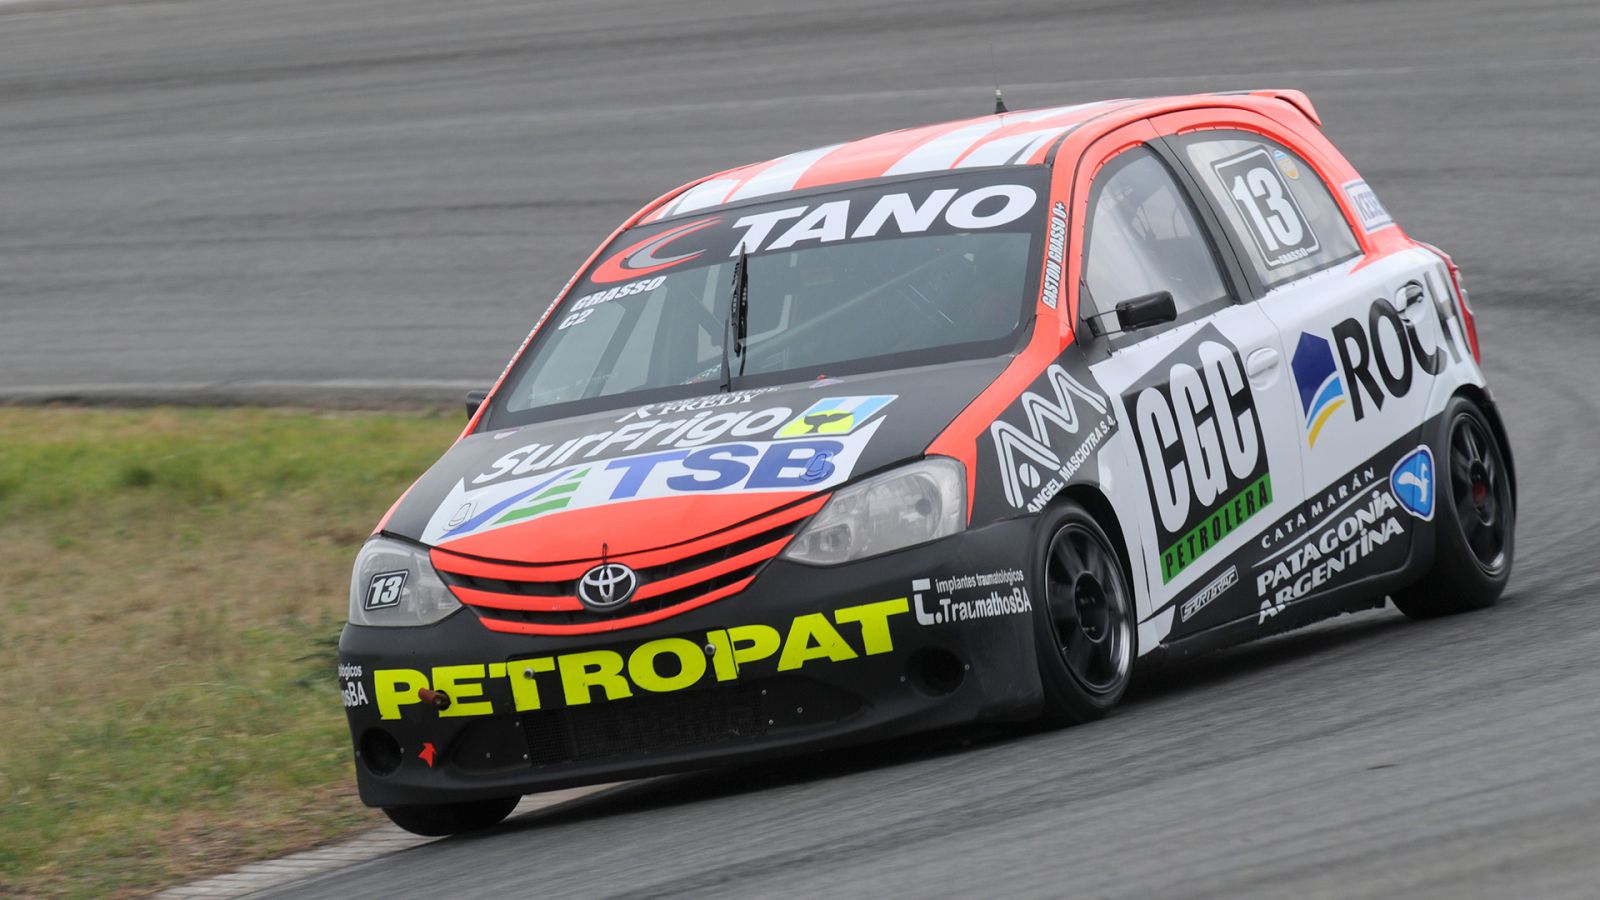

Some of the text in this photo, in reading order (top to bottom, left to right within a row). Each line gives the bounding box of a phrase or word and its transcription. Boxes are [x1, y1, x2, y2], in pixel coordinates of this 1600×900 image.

[729, 184, 1037, 257] TANO
[1048, 216, 1066, 263] GRASSO
[1231, 167, 1304, 252] 13
[558, 308, 594, 330] C2
[570, 275, 667, 312] GRASSO
[1042, 259, 1062, 310] GASTON
[604, 440, 844, 500] TSB
[1026, 478, 1064, 513] ANGEL
[1058, 426, 1104, 482] MASCIOTRA
[1136, 340, 1259, 533] CGC
[1165, 480, 1269, 578] PETROLERA
[1256, 490, 1398, 597] PATAGONIA
[371, 576, 403, 605] 13
[935, 576, 977, 595] implantes
[1258, 516, 1405, 625] ARGENTINA
[374, 597, 910, 721] PETROPAT
